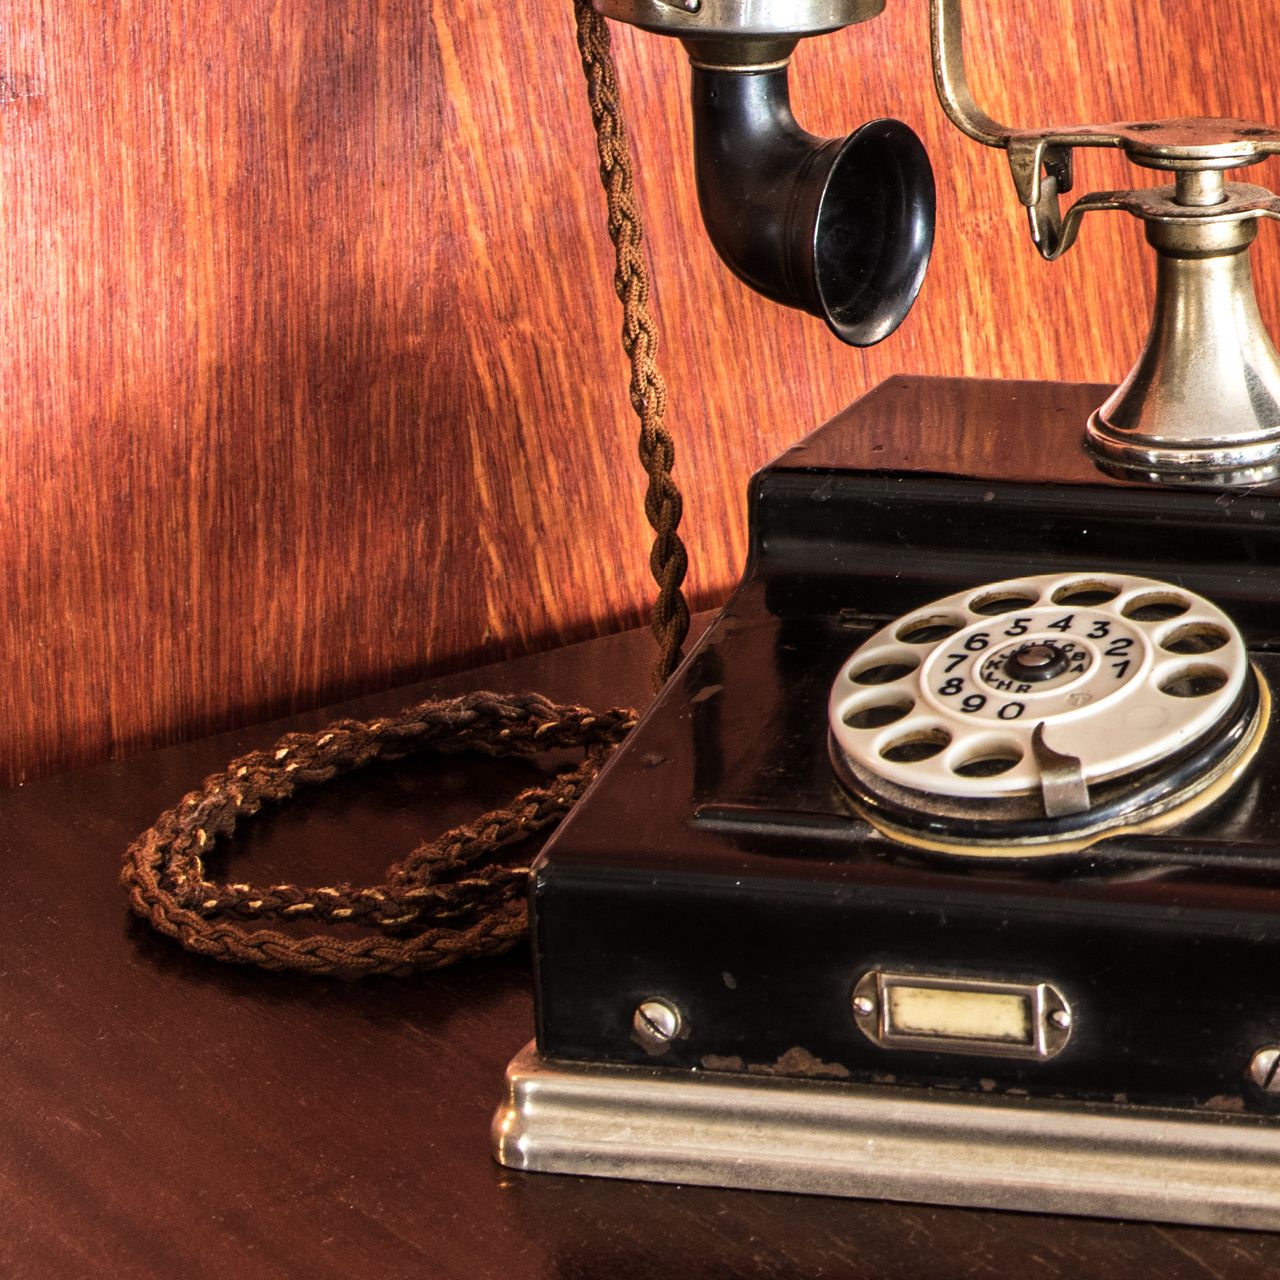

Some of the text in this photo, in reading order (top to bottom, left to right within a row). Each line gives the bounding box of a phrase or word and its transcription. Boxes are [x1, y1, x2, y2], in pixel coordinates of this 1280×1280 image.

[938, 614, 1134, 720] 1 2 3 4 5 6 7 8 9 0
